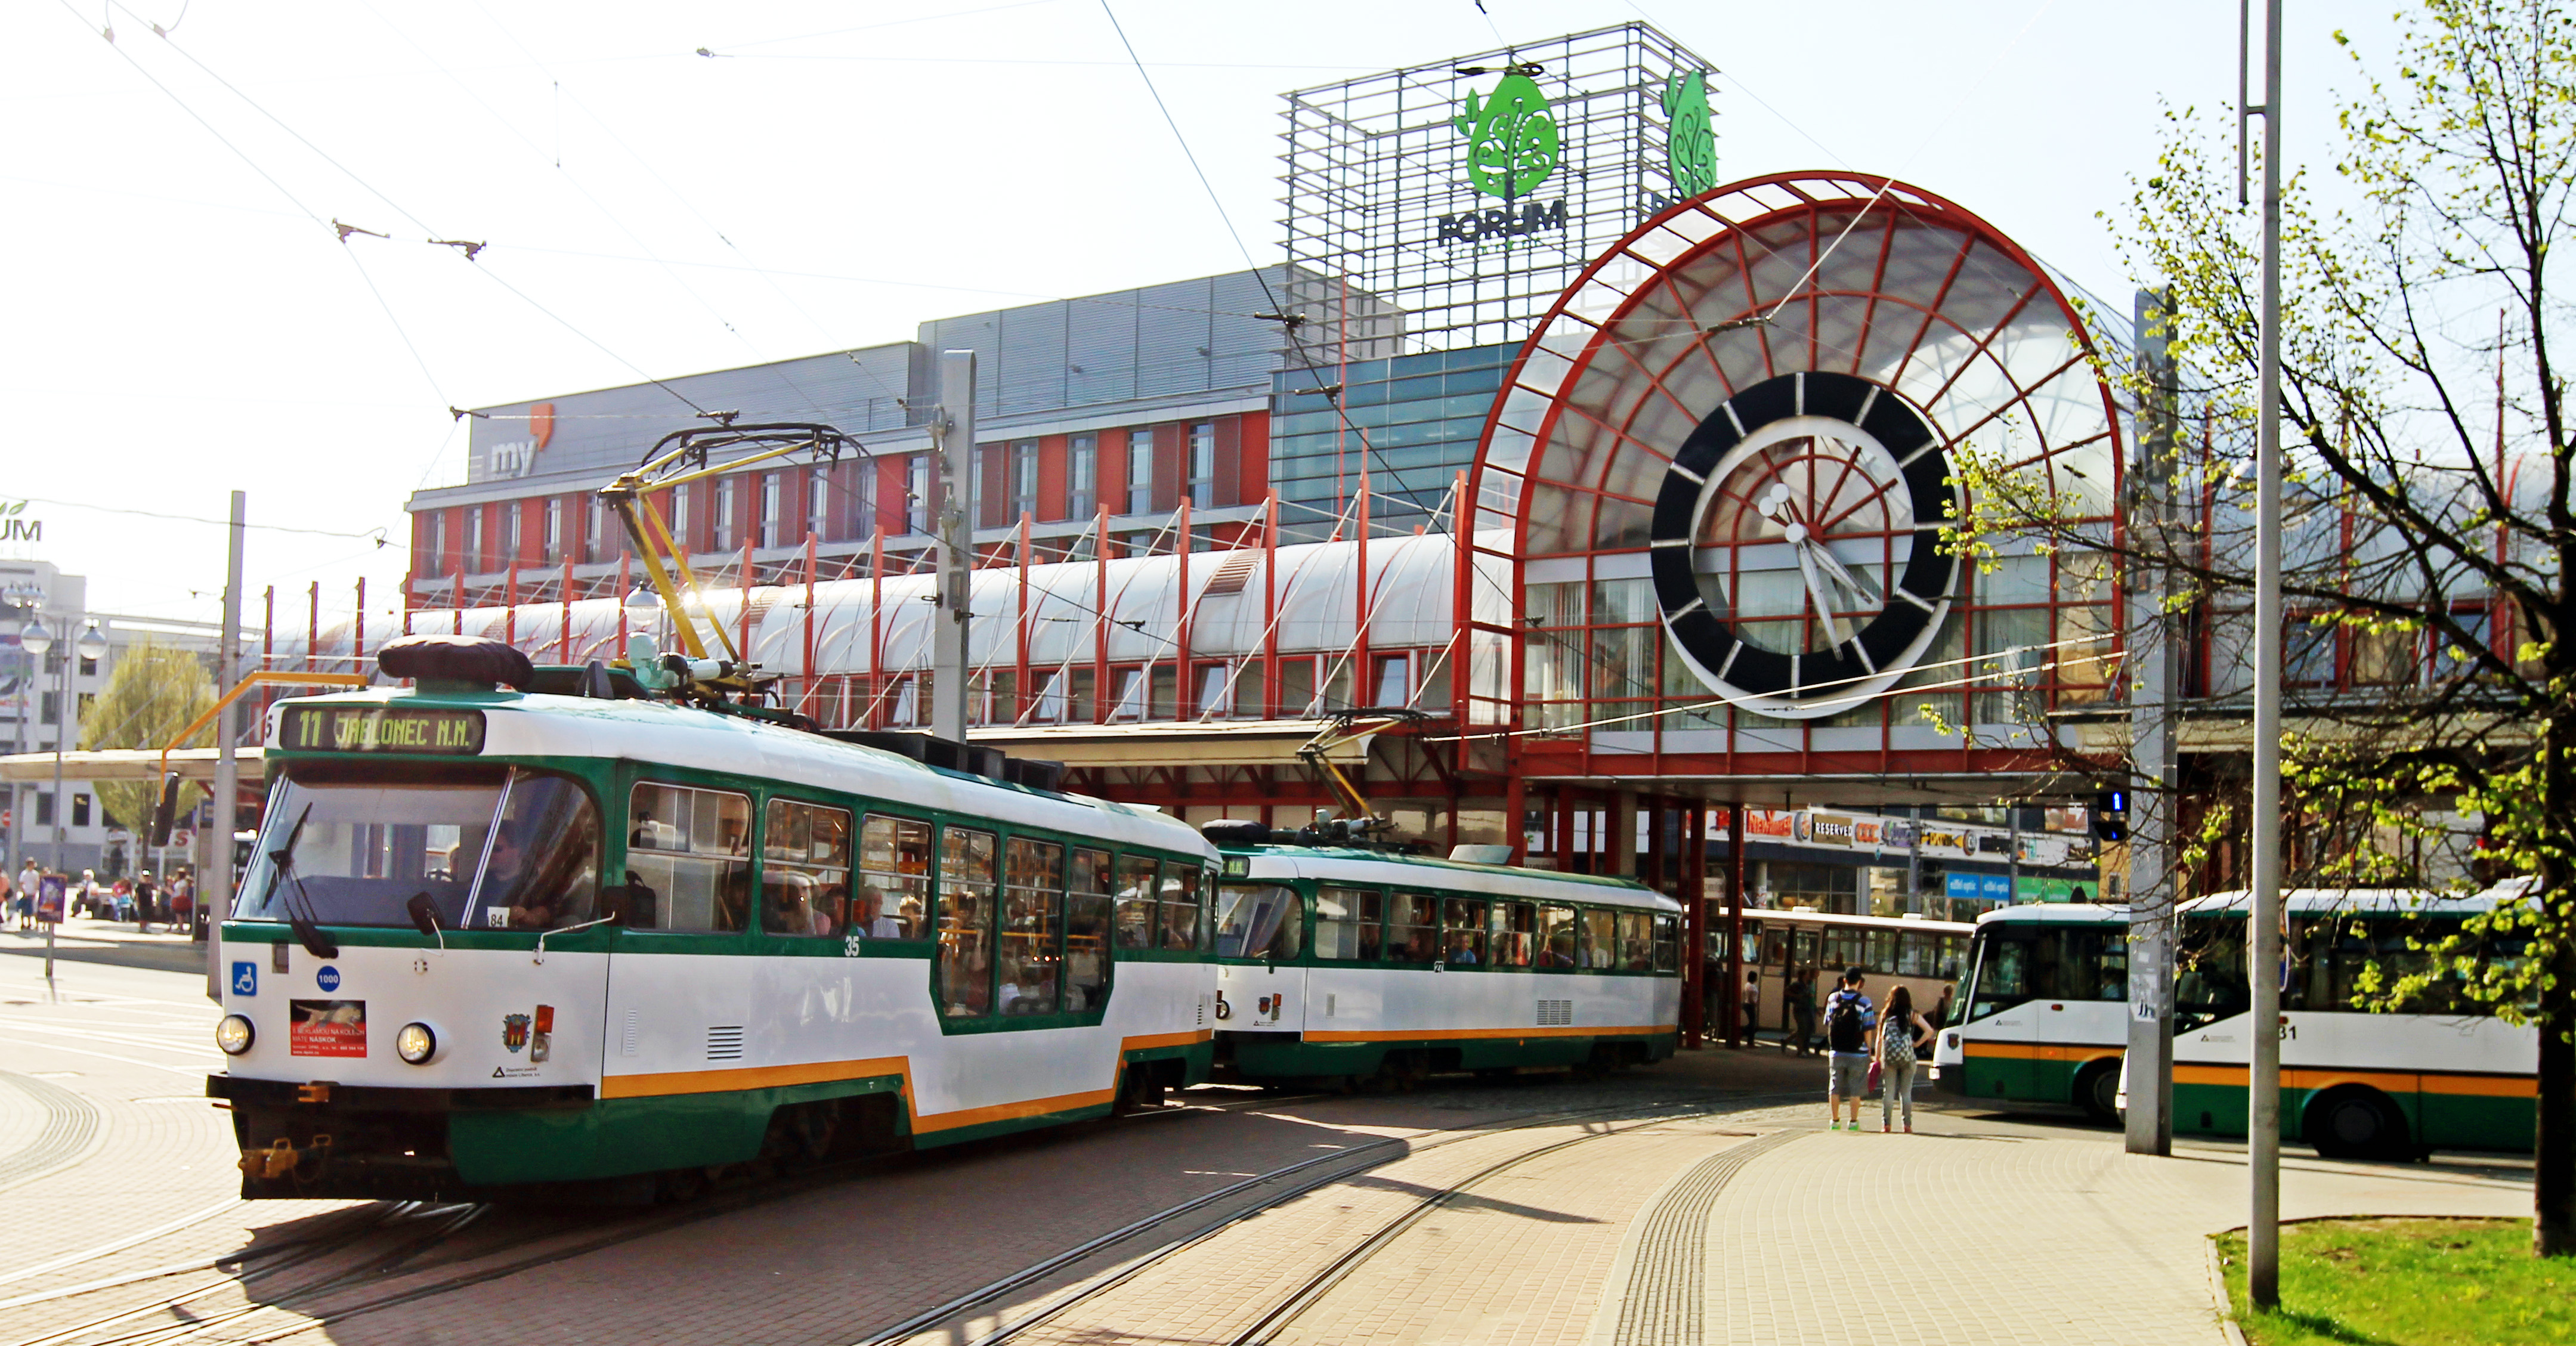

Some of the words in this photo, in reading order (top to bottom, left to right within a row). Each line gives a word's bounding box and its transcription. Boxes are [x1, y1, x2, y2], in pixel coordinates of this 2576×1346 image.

[1439, 200, 1565, 247] FORUM
[491, 439, 539, 477] my
[299, 710, 323, 747] 11
[335, 717, 429, 745] JABLONEC
[436, 719, 469, 746] N.N.
[1815, 822, 1853, 837] RESERVED
[1856, 823, 1879, 843] CCC
[490, 914, 503, 927] 84
[845, 936, 859, 957] 35
[1434, 961, 1443, 973] 27
[318, 974, 339, 983] 1000
